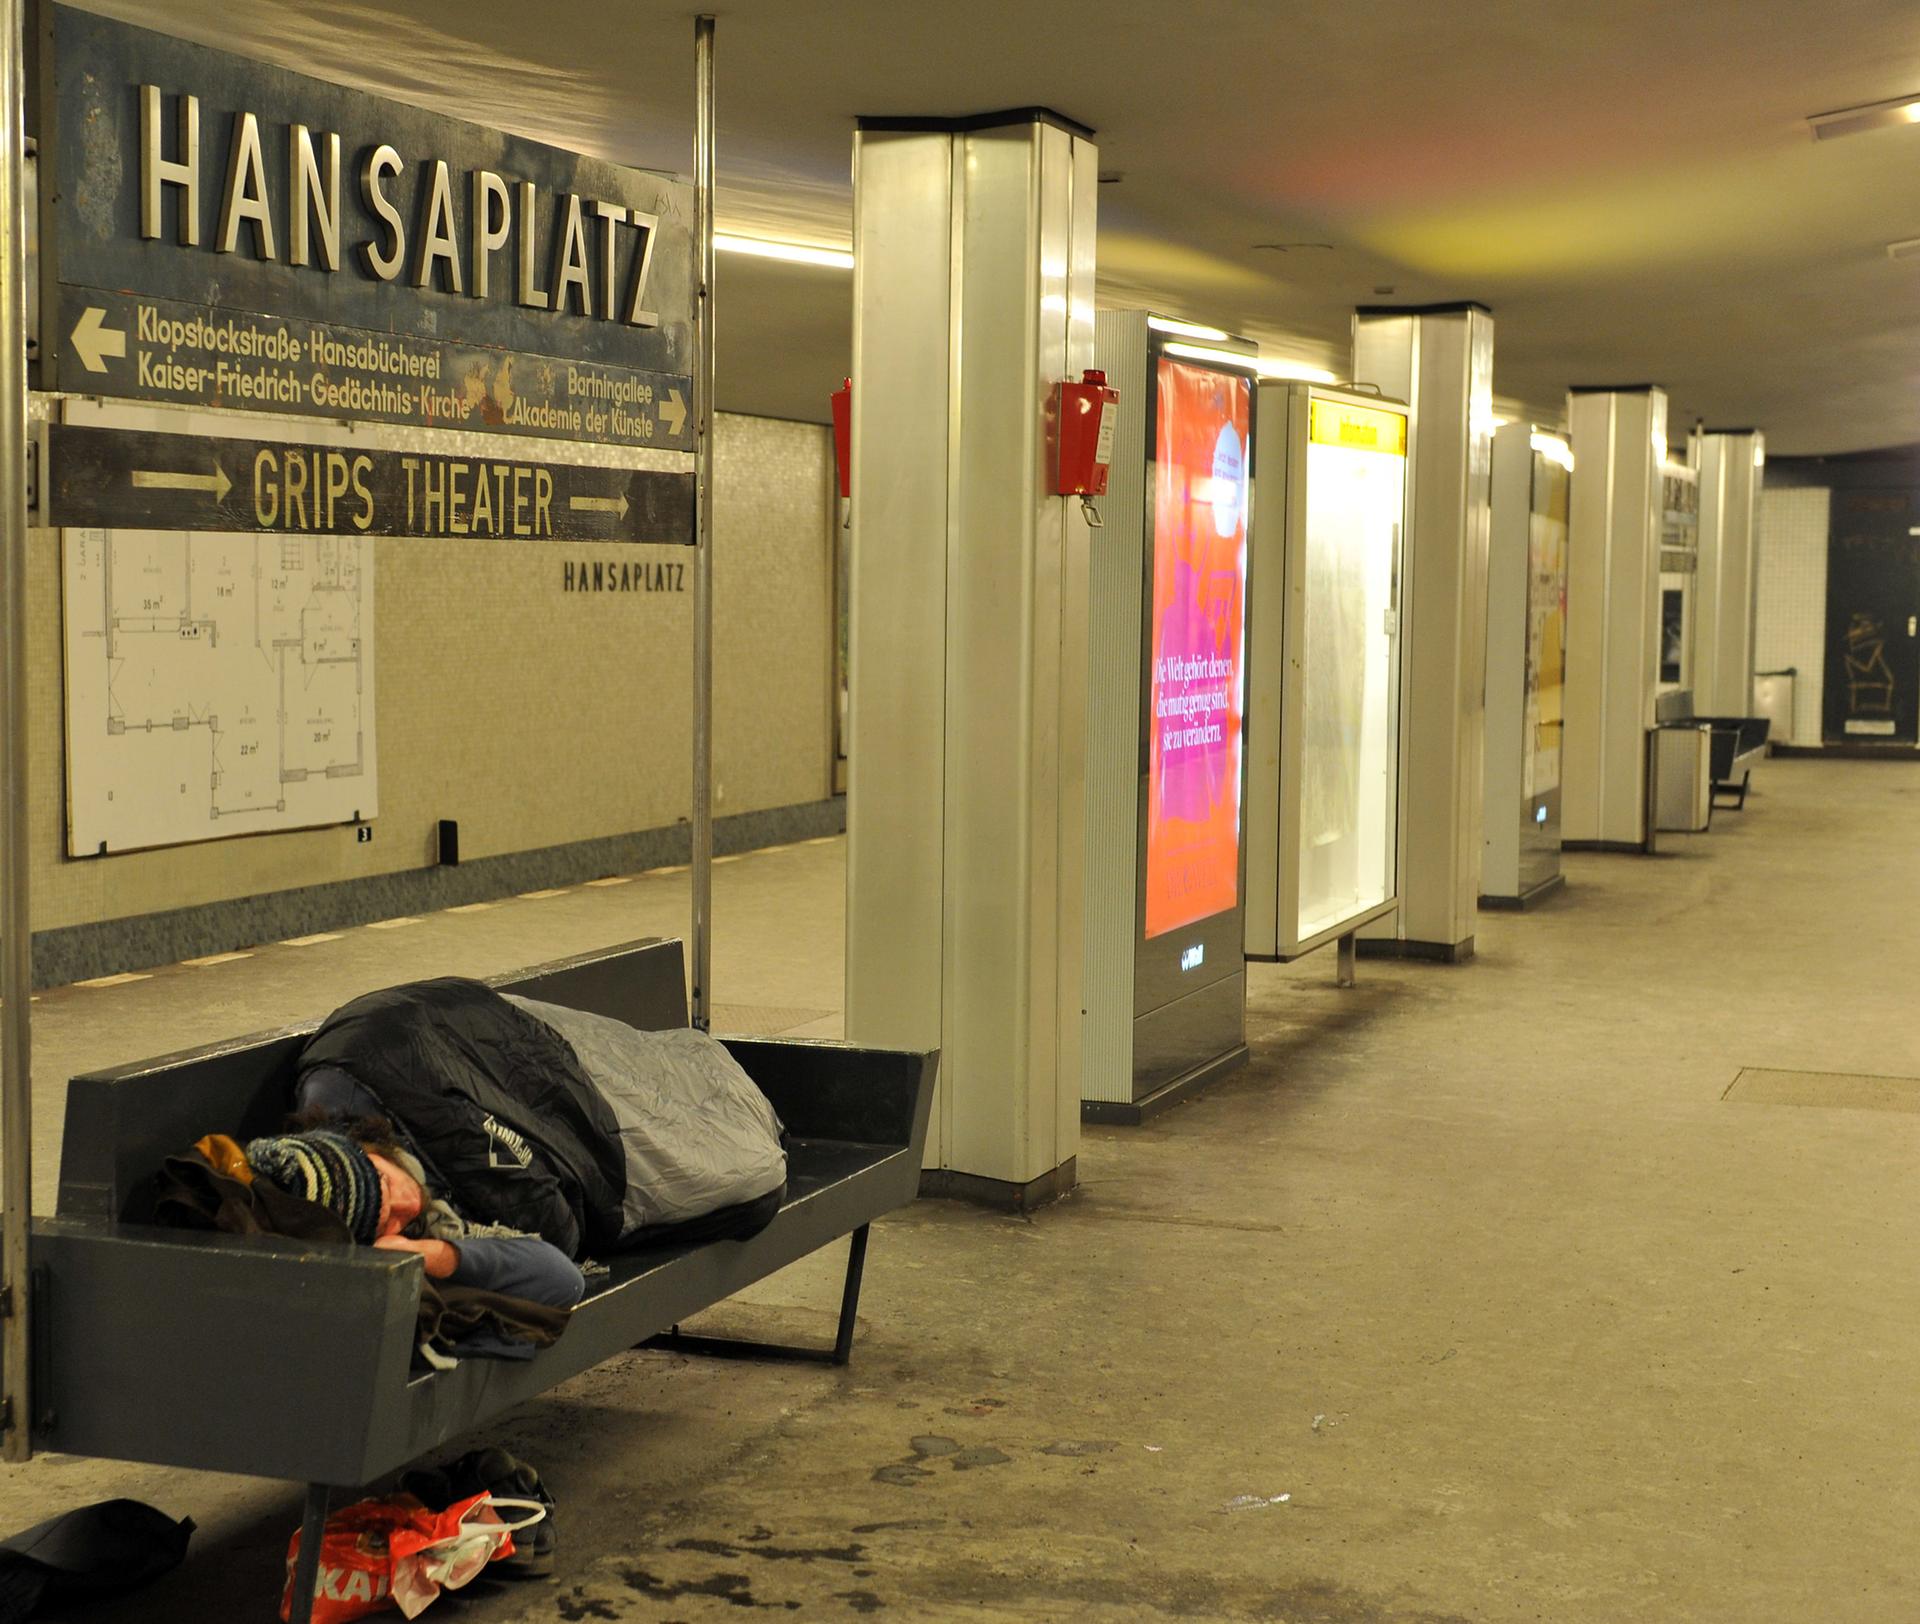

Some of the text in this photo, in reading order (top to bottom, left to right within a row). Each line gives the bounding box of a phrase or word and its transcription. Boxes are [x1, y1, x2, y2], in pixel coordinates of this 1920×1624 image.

[139, 84, 660, 328] HANSAPLATZ
[137, 304, 440, 379] Klopstockstraße Hansabücherei
[138, 350, 471, 420] Kaiser-Friedrich-Gedächtnis-Kirche
[568, 367, 653, 407] Bartningallee
[512, 396, 653, 438] Akademie der Künste
[254, 449, 553, 536] GRIPS THEATER
[563, 561, 685, 592] HANSAPLATZ
[1167, 655, 1184, 681] Welt
[1184, 653, 1208, 688] gehört
